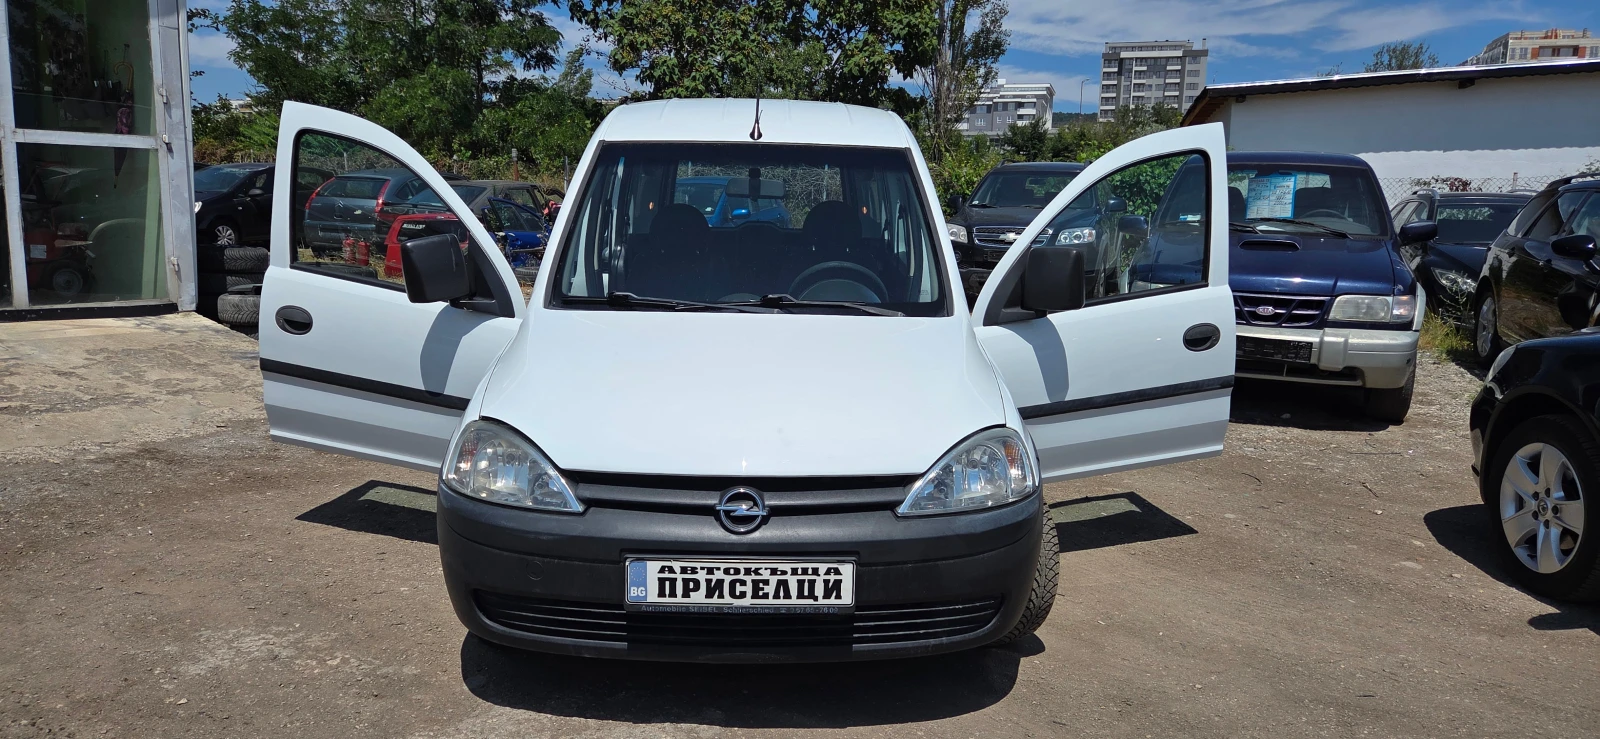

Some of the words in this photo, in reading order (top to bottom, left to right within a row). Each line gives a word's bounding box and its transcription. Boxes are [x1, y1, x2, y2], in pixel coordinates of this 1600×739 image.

[657, 565, 843, 577] АВТОКЪЩА
[630, 587, 646, 597] BG
[657, 577, 843, 602] ПРИСЕЛЦИ
